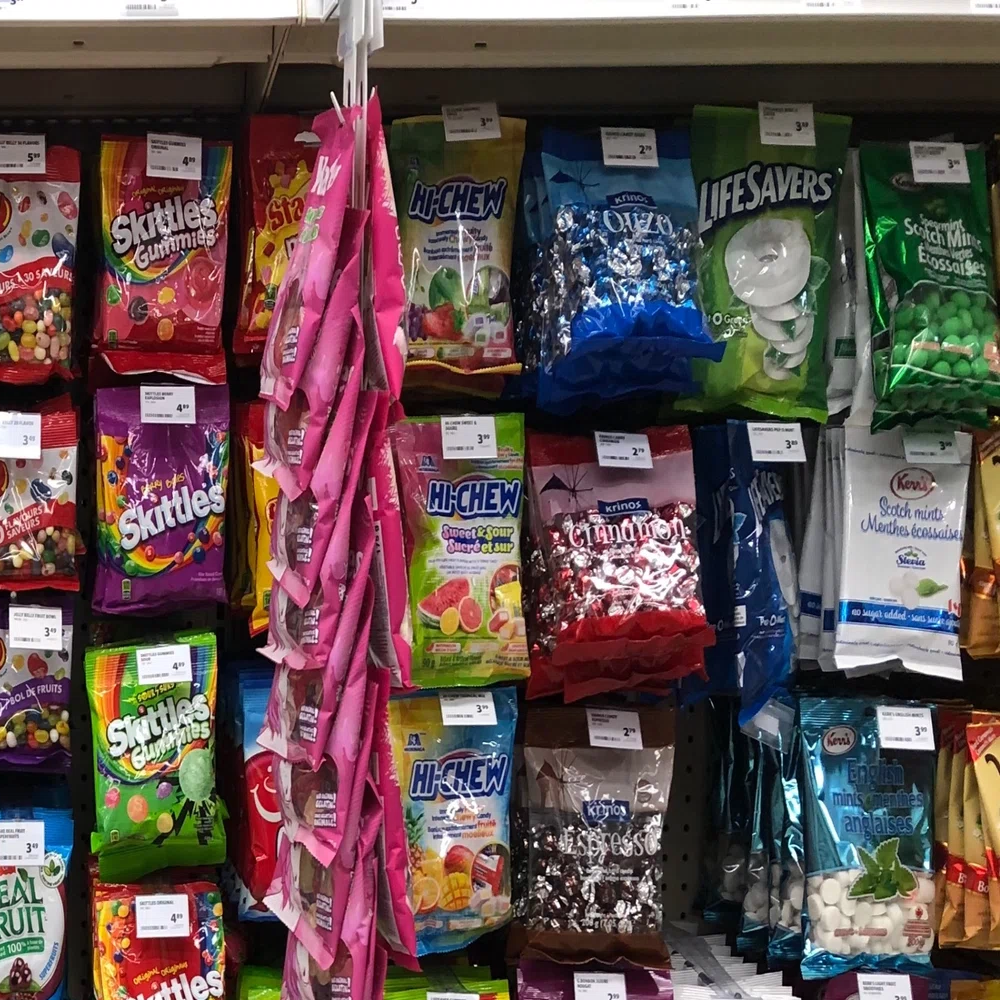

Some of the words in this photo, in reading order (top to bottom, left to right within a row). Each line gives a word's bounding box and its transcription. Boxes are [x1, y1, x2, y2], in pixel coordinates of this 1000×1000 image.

[409, 180, 507, 220] HI-CHEW
[111, 196, 218, 255] Skittles
[136, 230, 217, 270] Gummies
[427, 479, 522, 518] HI-CHEW
[605, 501, 642, 513] krinos
[879, 496, 911, 519] Scotch
[914, 506, 944, 521] mints
[7, 517, 41, 540] SAVEURS
[118, 485, 225, 551] Skittles
[861, 512, 909, 538] Menthes
[569, 521, 685, 550] Cinnamon
[37, 684, 62, 696] FRUITS
[108, 695, 212, 758] Skittles
[410, 755, 507, 798] HI-CHEW
[846, 759, 904, 791] English
[832, 791, 863, 808] mints
[843, 811, 914, 841] anglaises
